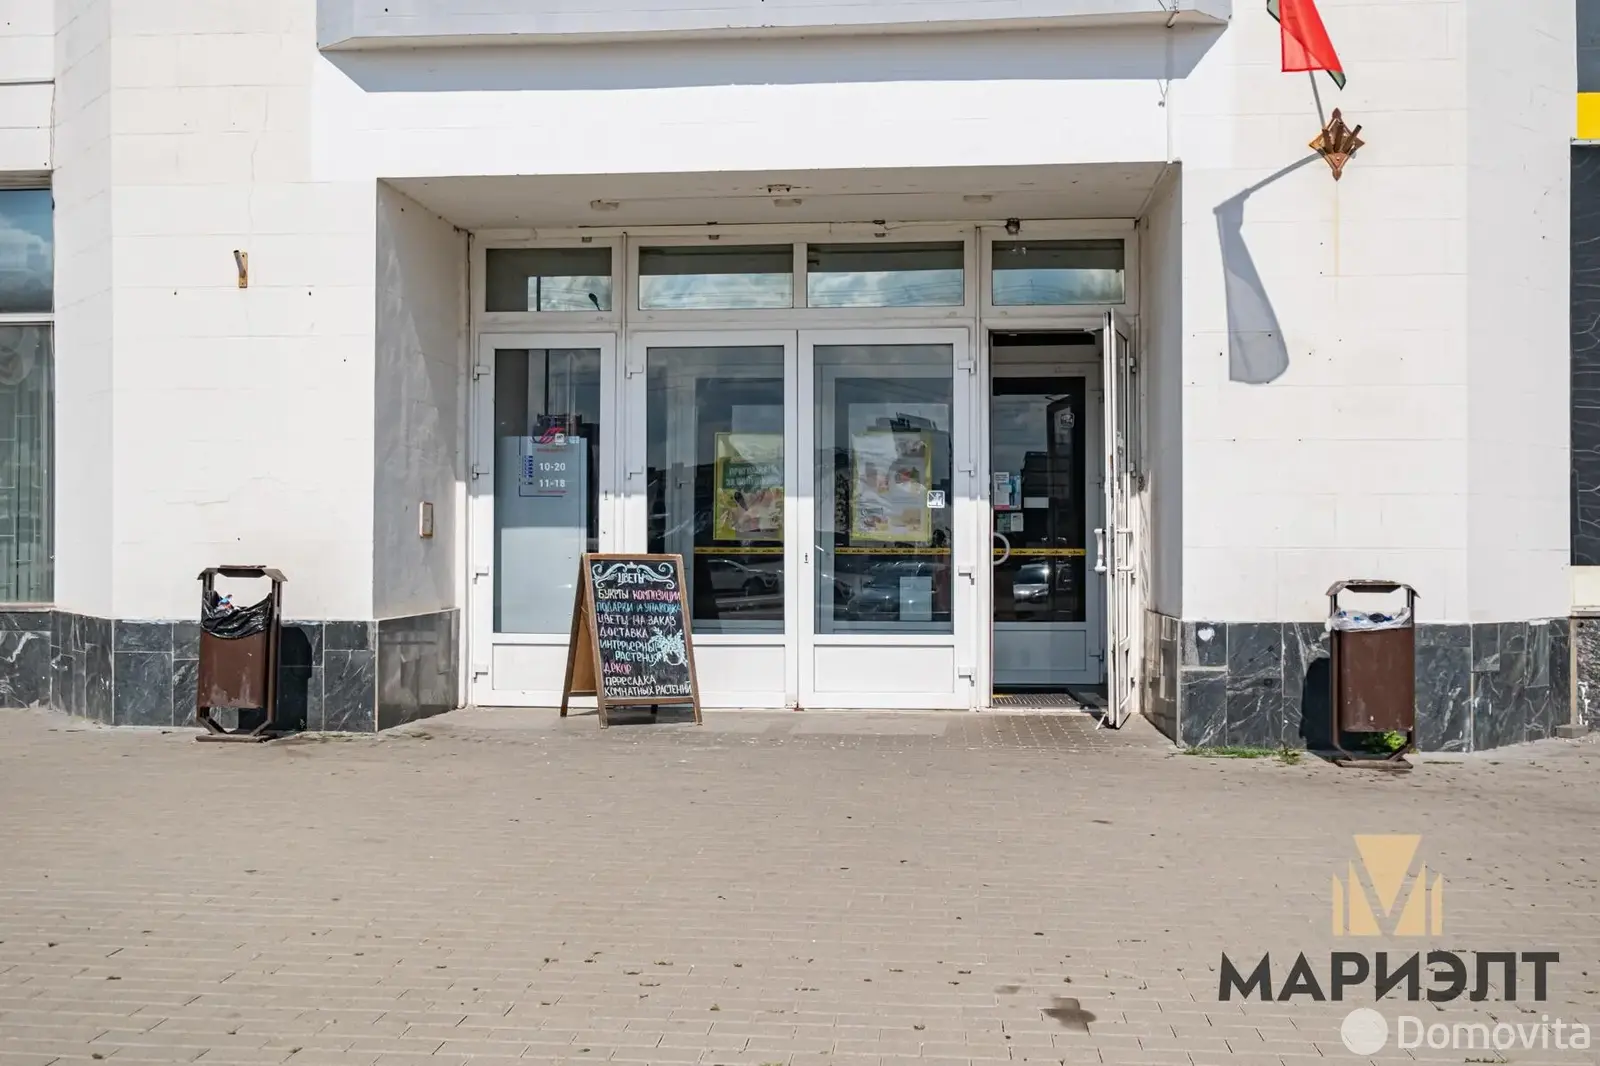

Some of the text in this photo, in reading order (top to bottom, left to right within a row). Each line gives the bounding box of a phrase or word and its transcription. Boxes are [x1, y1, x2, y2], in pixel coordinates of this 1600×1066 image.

[539, 462, 566, 472] 10-20
[539, 479, 566, 488] 11-18
[617, 573, 645, 586] ЦВЕТЫ
[597, 613, 677, 626] ЦВЕТЫ НА ЗАКАЗ
[600, 626, 649, 638] ДОСТАВКА
[604, 662, 632, 675] ДЕКОР
